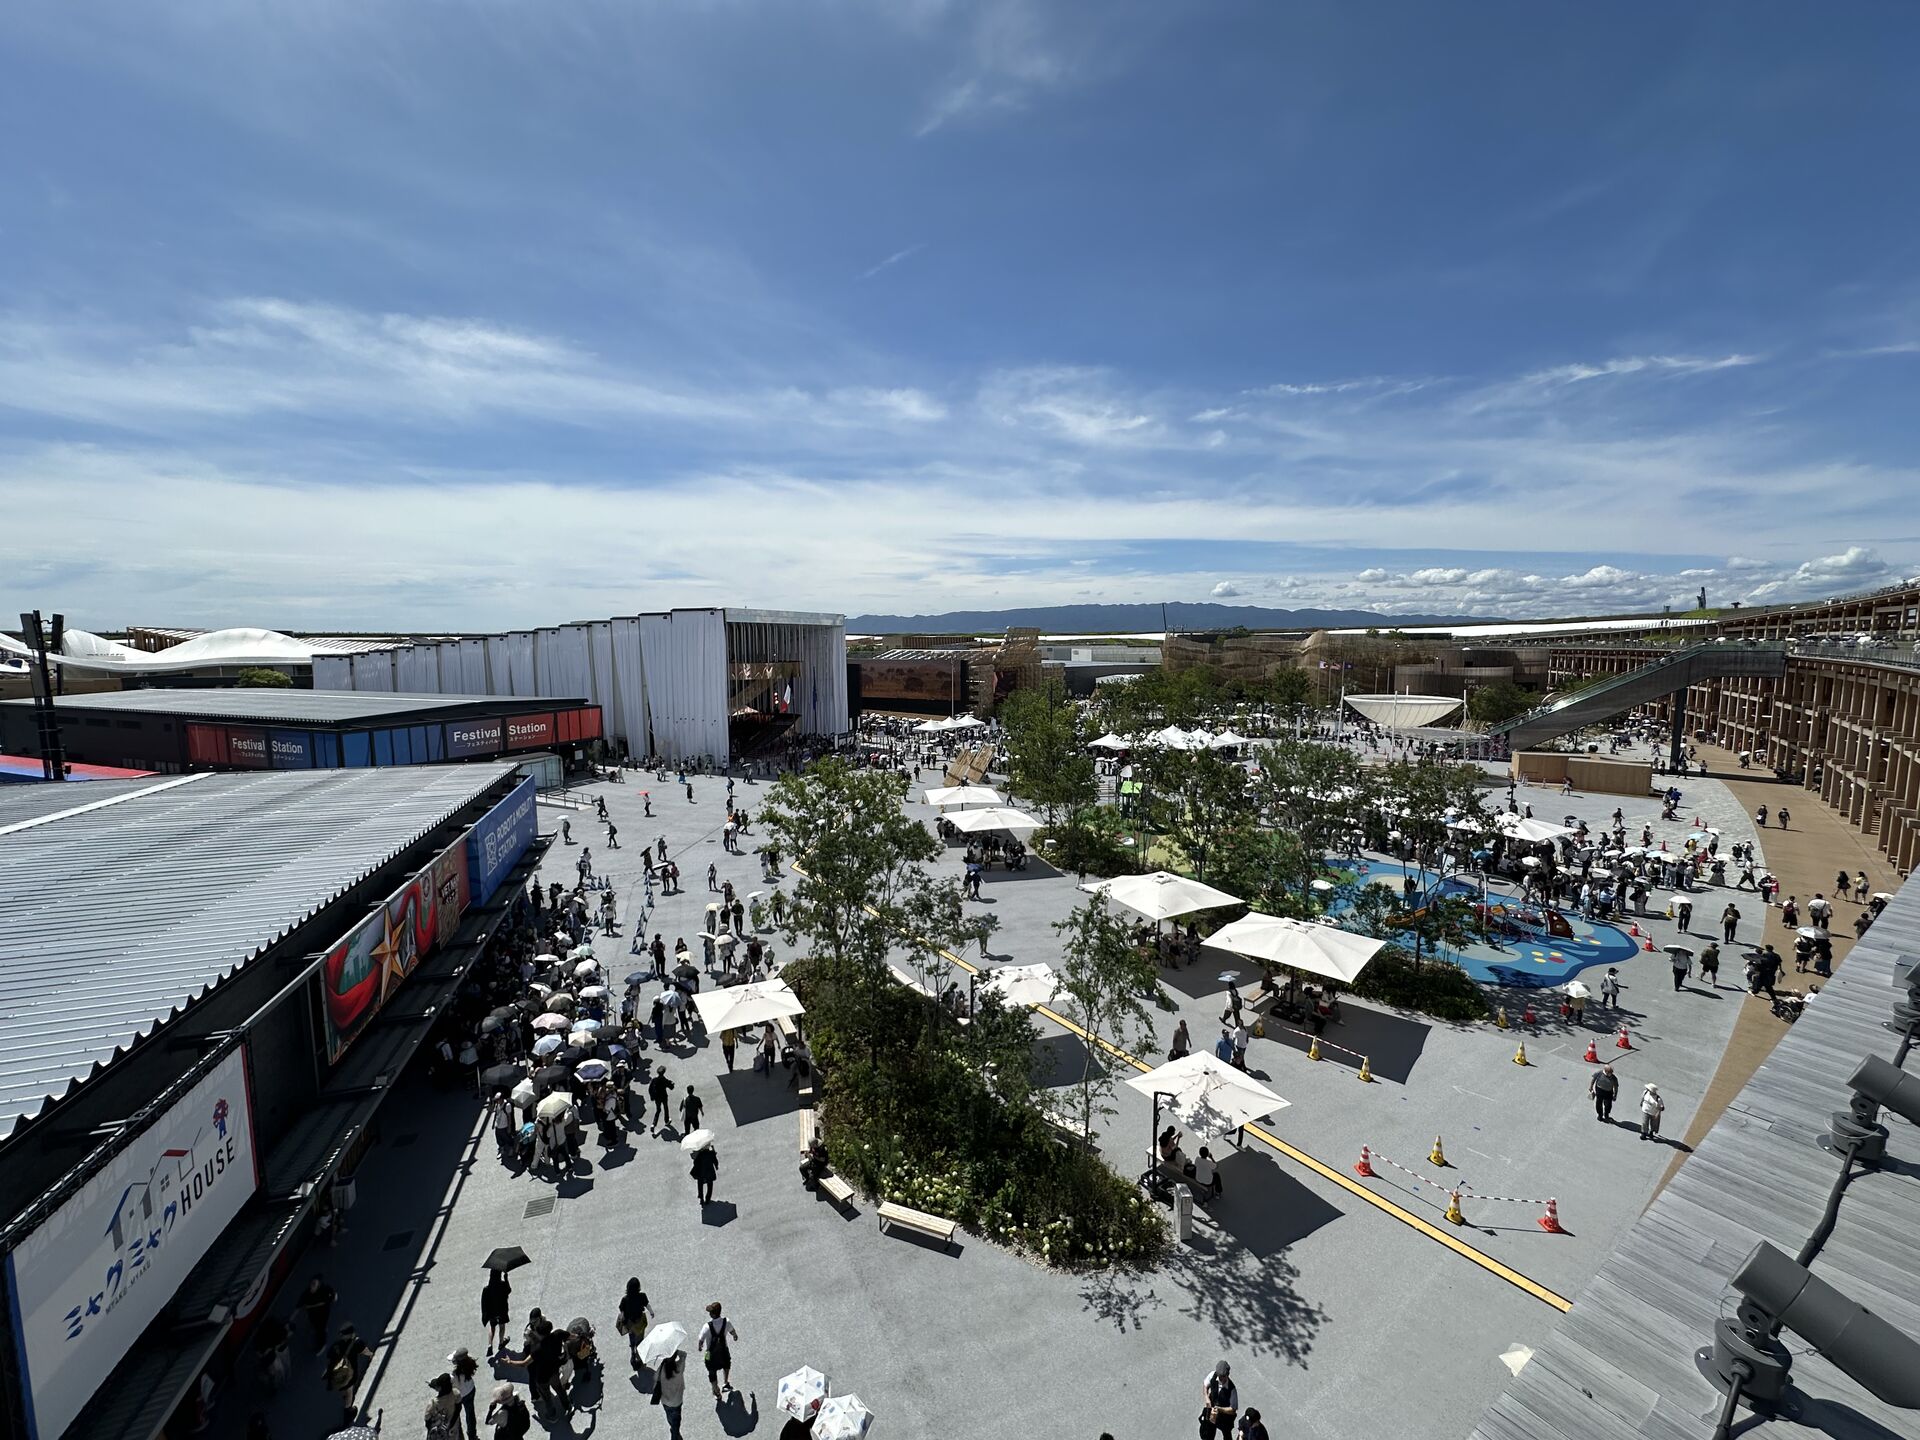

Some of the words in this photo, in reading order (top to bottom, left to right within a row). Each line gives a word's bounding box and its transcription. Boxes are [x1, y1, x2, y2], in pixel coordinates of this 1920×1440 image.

[232, 738, 265, 751] Festival
[272, 740, 303, 754] Station
[453, 727, 500, 742] Festival
[508, 723, 546, 735] Station
[497, 814, 513, 841] ROBOT
[498, 831, 517, 862] STATION
[180, 1136, 235, 1216] HOUSE
